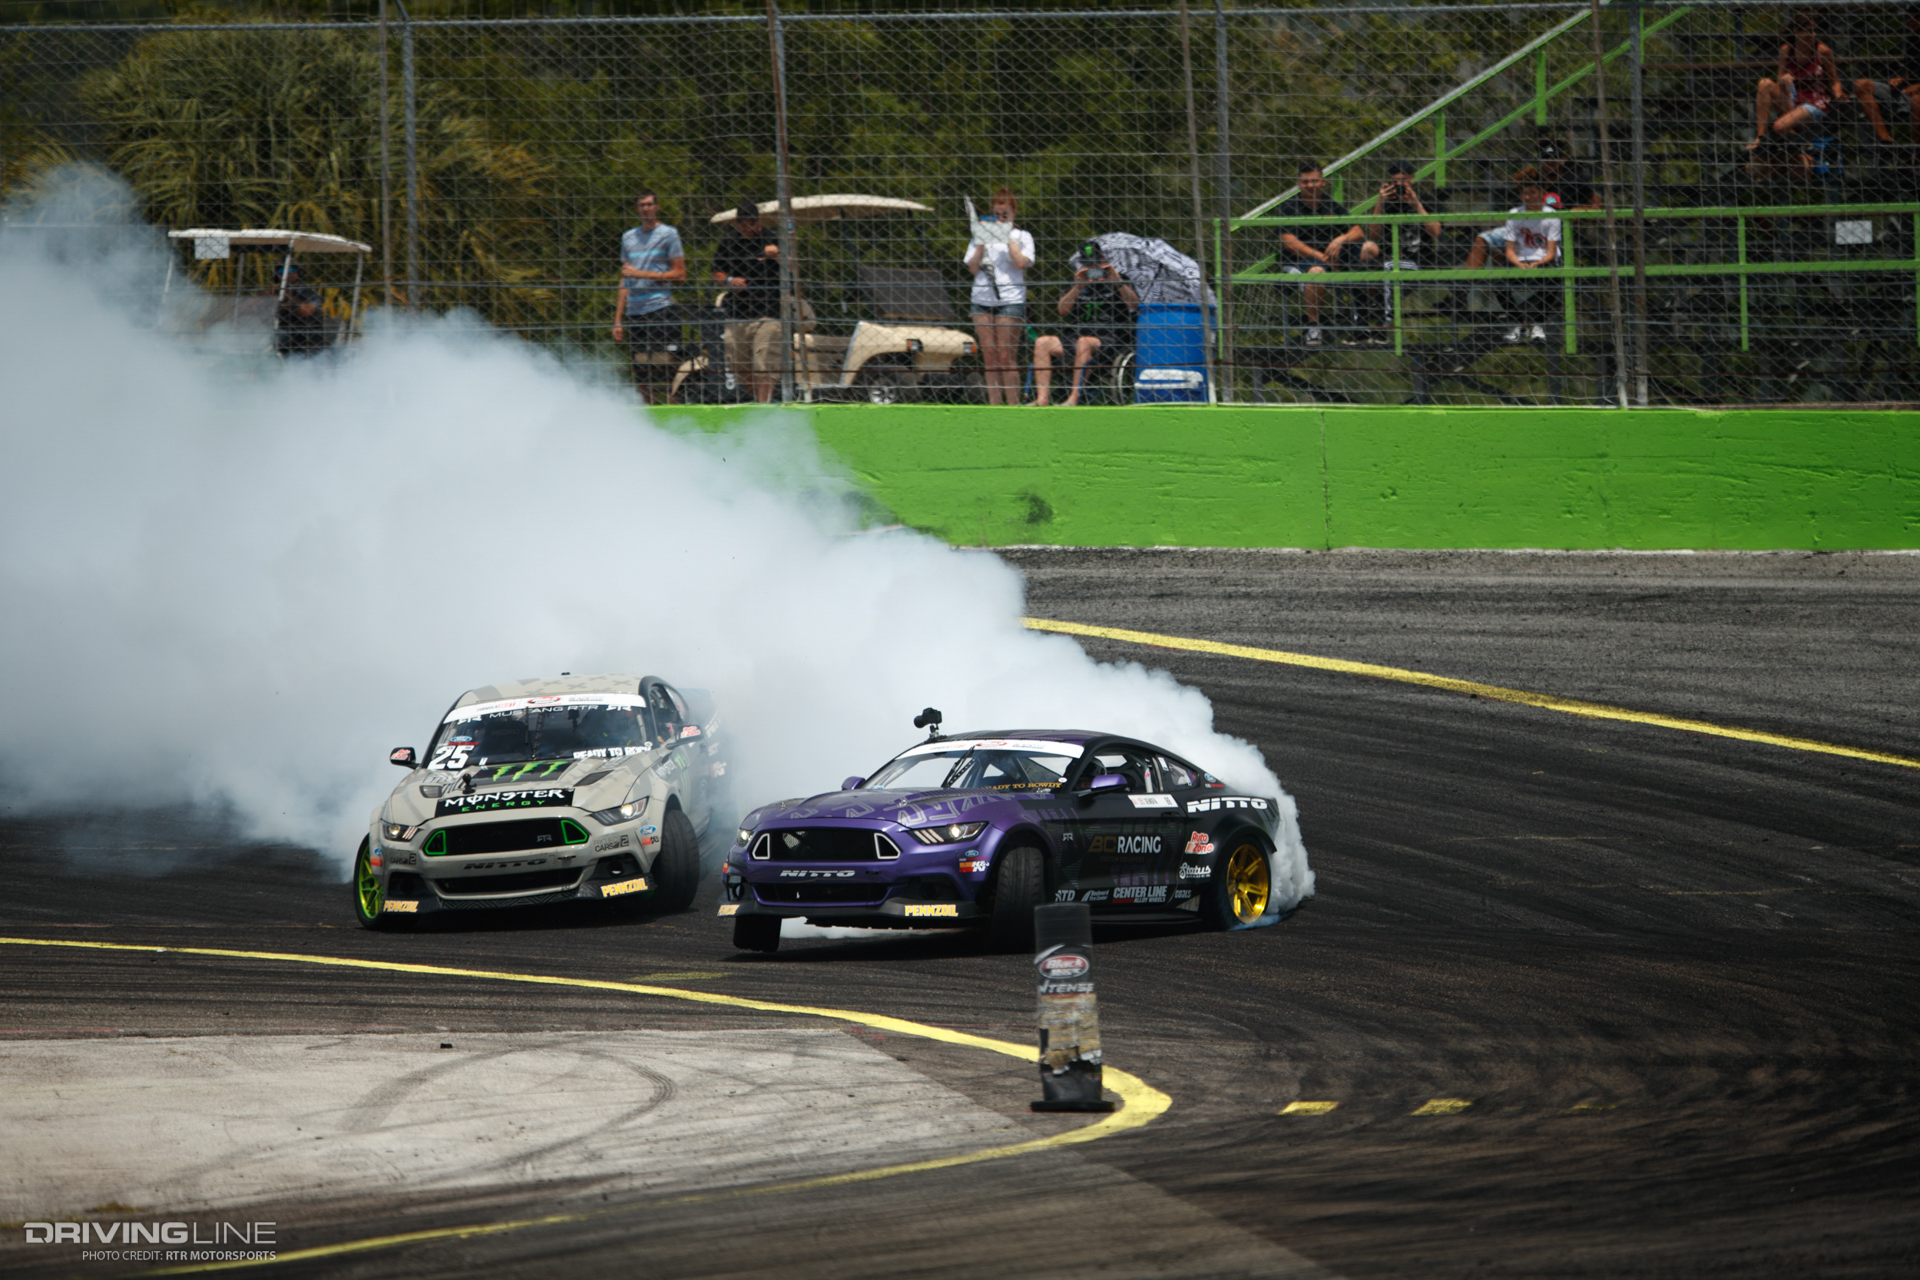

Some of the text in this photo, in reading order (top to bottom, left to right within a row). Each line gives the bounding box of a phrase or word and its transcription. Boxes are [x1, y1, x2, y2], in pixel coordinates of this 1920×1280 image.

[489, 706, 564, 719] MUSTANG
[427, 745, 475, 770] 25
[444, 789, 565, 807] MONSTER
[1187, 797, 1267, 813] NITTO
[461, 800, 545, 812] ENERGY
[621, 835, 629, 847] 2
[1087, 836, 1162, 853] BC RACING
[464, 859, 547, 870] NITTO
[601, 878, 648, 898] PENNZOIL
[1113, 886, 1147, 899] CENTER
[1148, 885, 1168, 898] LINE
[905, 904, 959, 917] PENNZOIL
